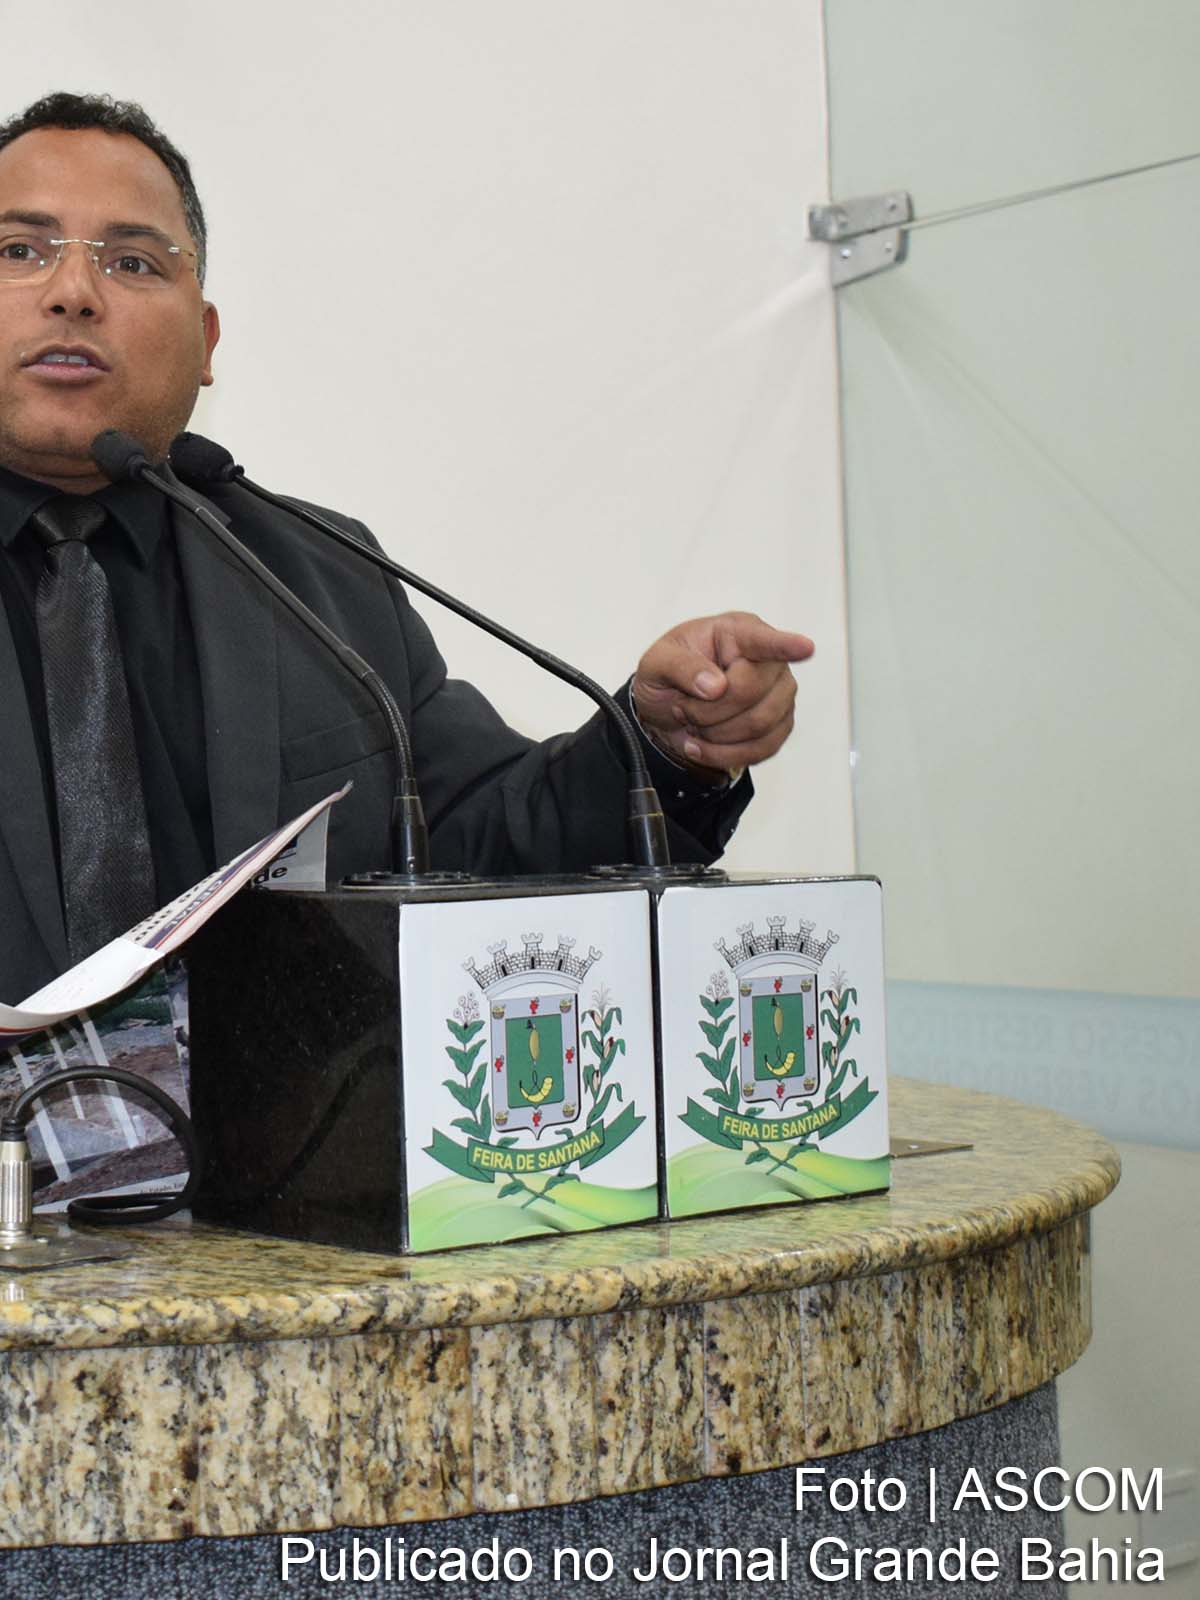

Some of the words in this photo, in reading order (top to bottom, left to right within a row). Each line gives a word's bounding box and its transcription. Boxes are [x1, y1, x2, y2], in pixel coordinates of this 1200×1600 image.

[722, 1116, 759, 1138] FEIRA
[762, 1123, 779, 1139] DE
[782, 1104, 838, 1136] SANTANA
[472, 1147, 513, 1171] FEIRA
[516, 1154, 536, 1170] DE
[538, 1131, 600, 1168] SANTANA
